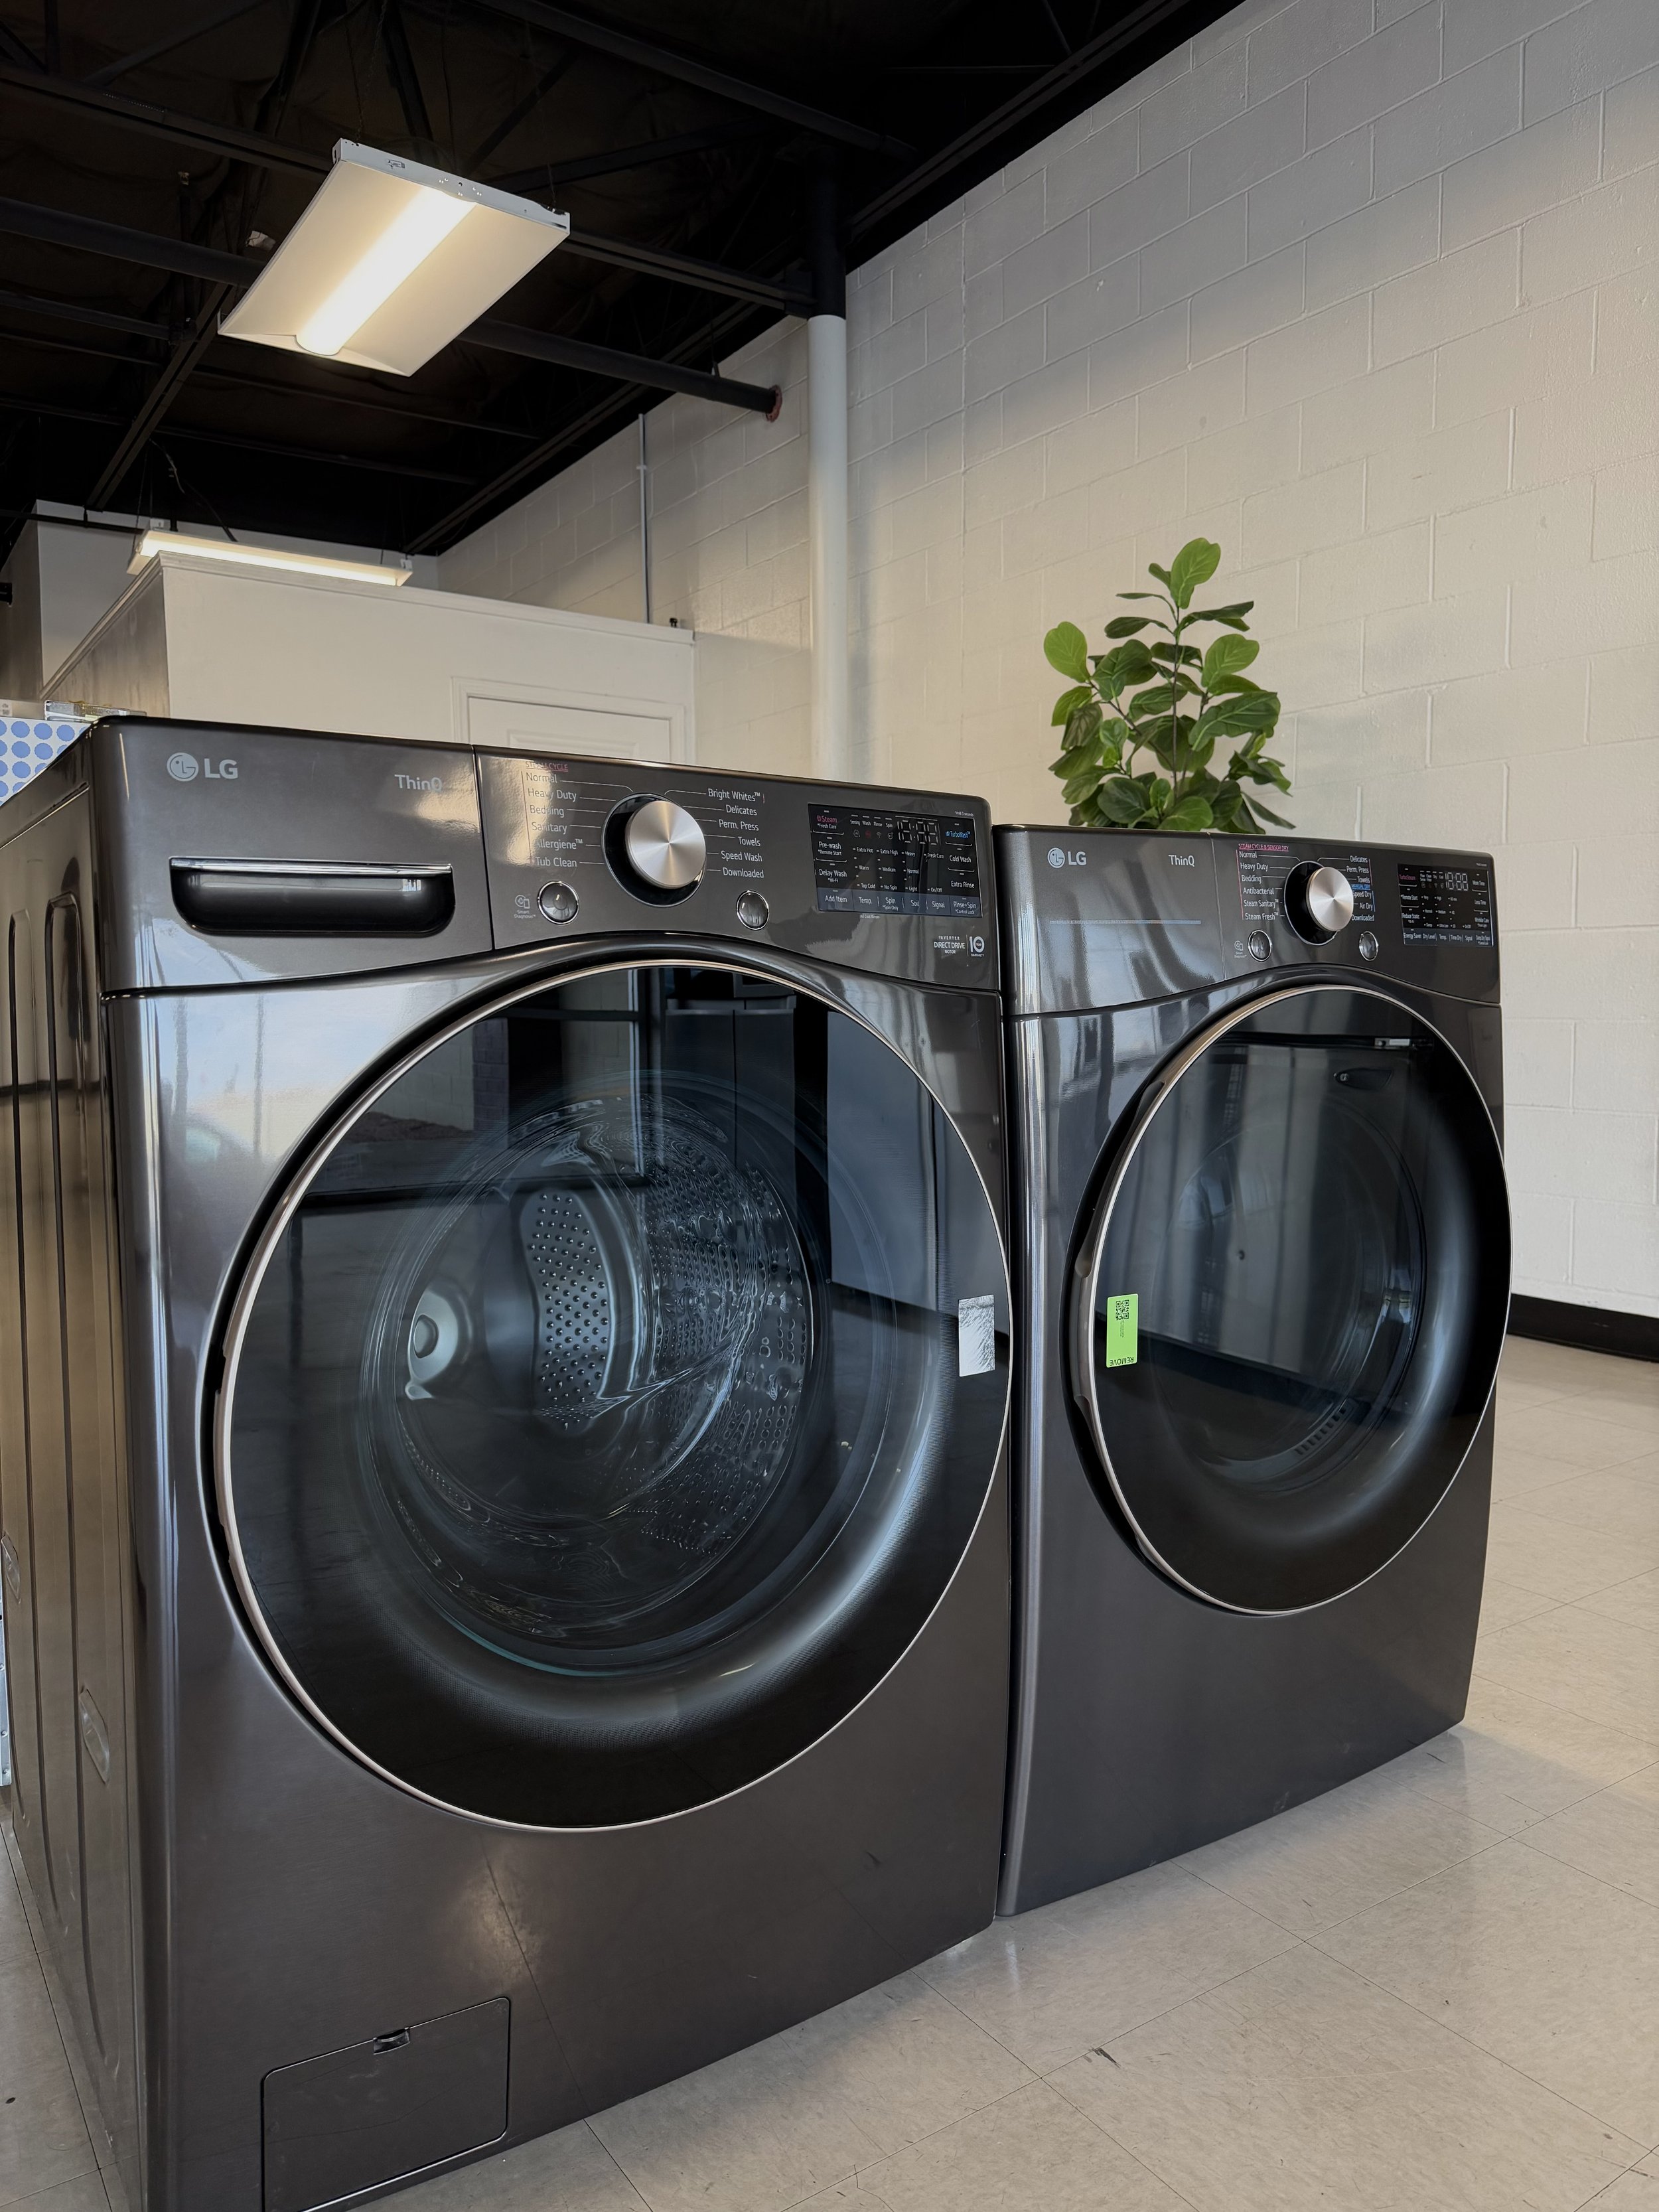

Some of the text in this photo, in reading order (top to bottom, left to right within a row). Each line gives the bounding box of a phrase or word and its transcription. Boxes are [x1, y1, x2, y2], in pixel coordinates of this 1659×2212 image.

[204, 758, 238, 779] LG
[394, 774, 443, 792] ThinQ
[526, 773, 557, 784] Normal
[528, 788, 577, 802] Heavy Duty
[708, 788, 730, 800] Bright
[726, 804, 757, 816] Delicates
[532, 822, 567, 834] Sanitary
[719, 819, 759, 831] Perm. Press
[738, 836, 760, 847] Towels
[818, 841, 841, 849] Pre-wash
[536, 857, 577, 867] Tub Clean
[721, 850, 762, 862] Speed Wash
[1068, 851, 1087, 865] LG
[1169, 854, 1194, 867] ThinQ
[723, 867, 764, 878] Downloaded
[819, 869, 833, 877] Delay
[1256, 863, 1268, 871] Duty
[1241, 875, 1262, 883] Bedding
[1352, 890, 1364, 899] Speed
[969, 936, 985, 953] 10
[1110, 1357, 1134, 1366] REMOVE
